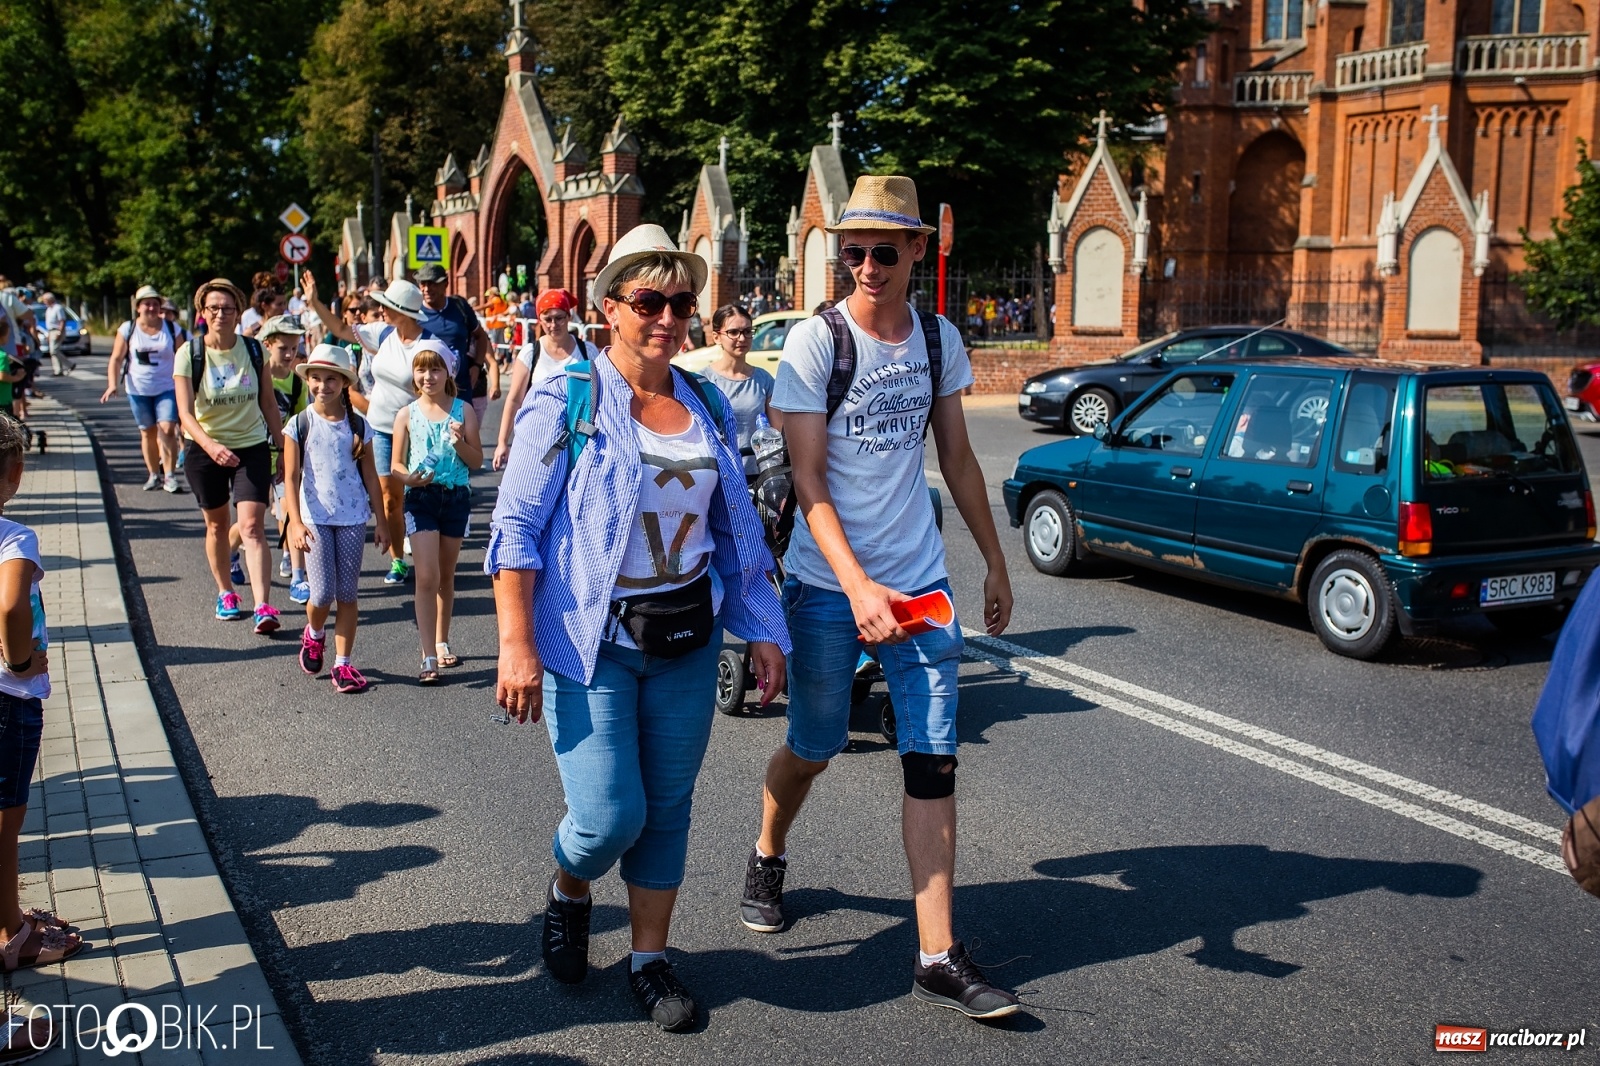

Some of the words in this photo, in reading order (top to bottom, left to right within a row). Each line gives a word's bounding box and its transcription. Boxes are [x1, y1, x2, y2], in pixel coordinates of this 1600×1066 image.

[845, 362, 900, 405] ENDLESS
[882, 375, 920, 389] SURFING
[228, 395, 237, 404] ME
[867, 391, 931, 417] California
[845, 414, 865, 437] 19
[856, 436, 902, 455] Malibu
[1489, 578, 1518, 598] SRC
[1521, 574, 1553, 594] K983
